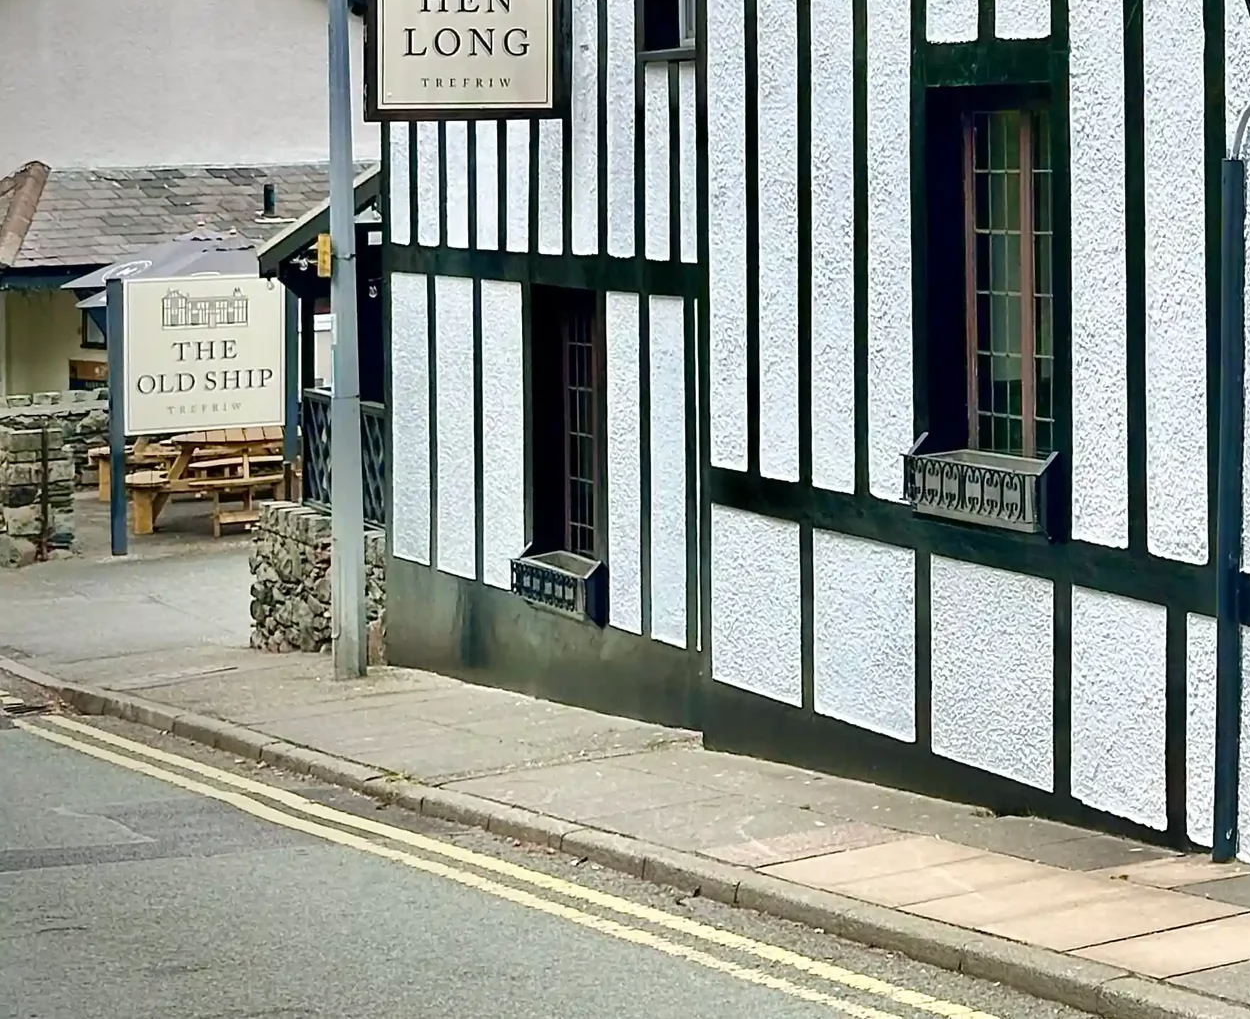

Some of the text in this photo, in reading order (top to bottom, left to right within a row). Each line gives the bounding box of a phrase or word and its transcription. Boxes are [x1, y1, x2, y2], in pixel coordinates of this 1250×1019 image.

[403, 28, 530, 57] LONG
[421, 78, 512, 88] TREFRIW
[171, 339, 238, 361] THE
[136, 368, 274, 394] OLD SHIP
